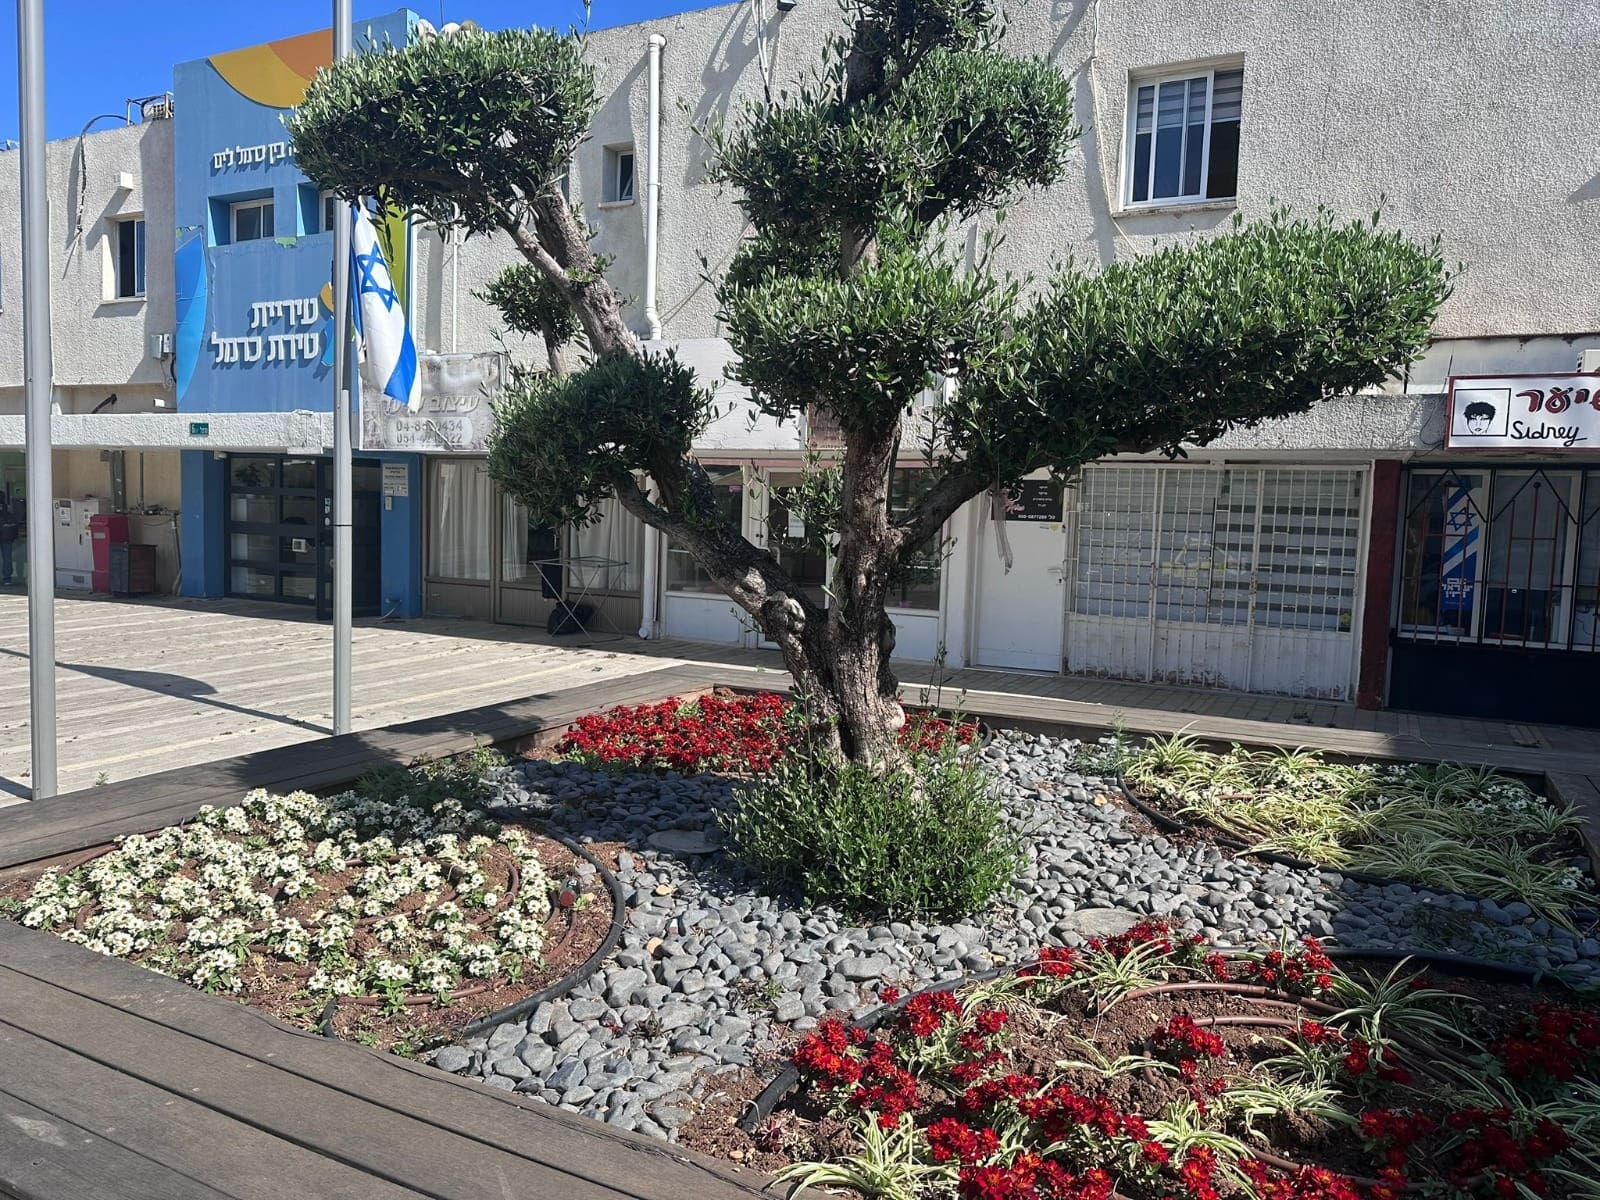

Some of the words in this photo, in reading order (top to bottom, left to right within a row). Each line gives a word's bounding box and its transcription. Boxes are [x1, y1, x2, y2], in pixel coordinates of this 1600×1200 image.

[213, 147, 234, 169] לים
[268, 141, 286, 164] בין
[251, 297, 319, 329] עיריית
[211, 331, 262, 363] כרמל
[267, 332, 319, 361] טירת
[1510, 420, 1588, 447] Sidney
